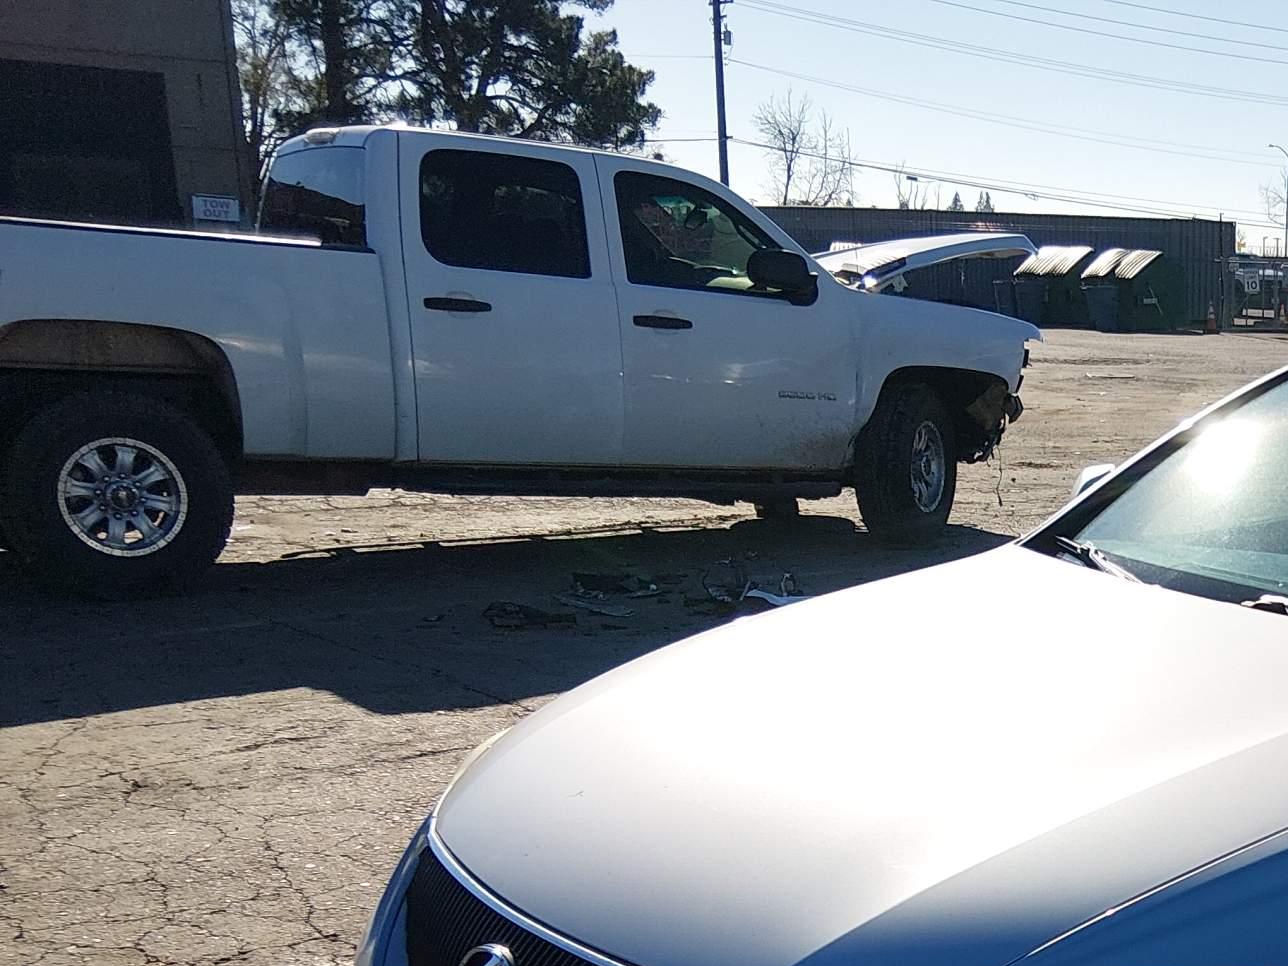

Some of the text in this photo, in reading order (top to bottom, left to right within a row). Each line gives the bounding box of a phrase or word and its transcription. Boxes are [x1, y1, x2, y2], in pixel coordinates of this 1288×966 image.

[202, 199, 231, 209] TOW
[203, 208, 230, 217] OUT
[1246, 280, 1258, 290] 10
